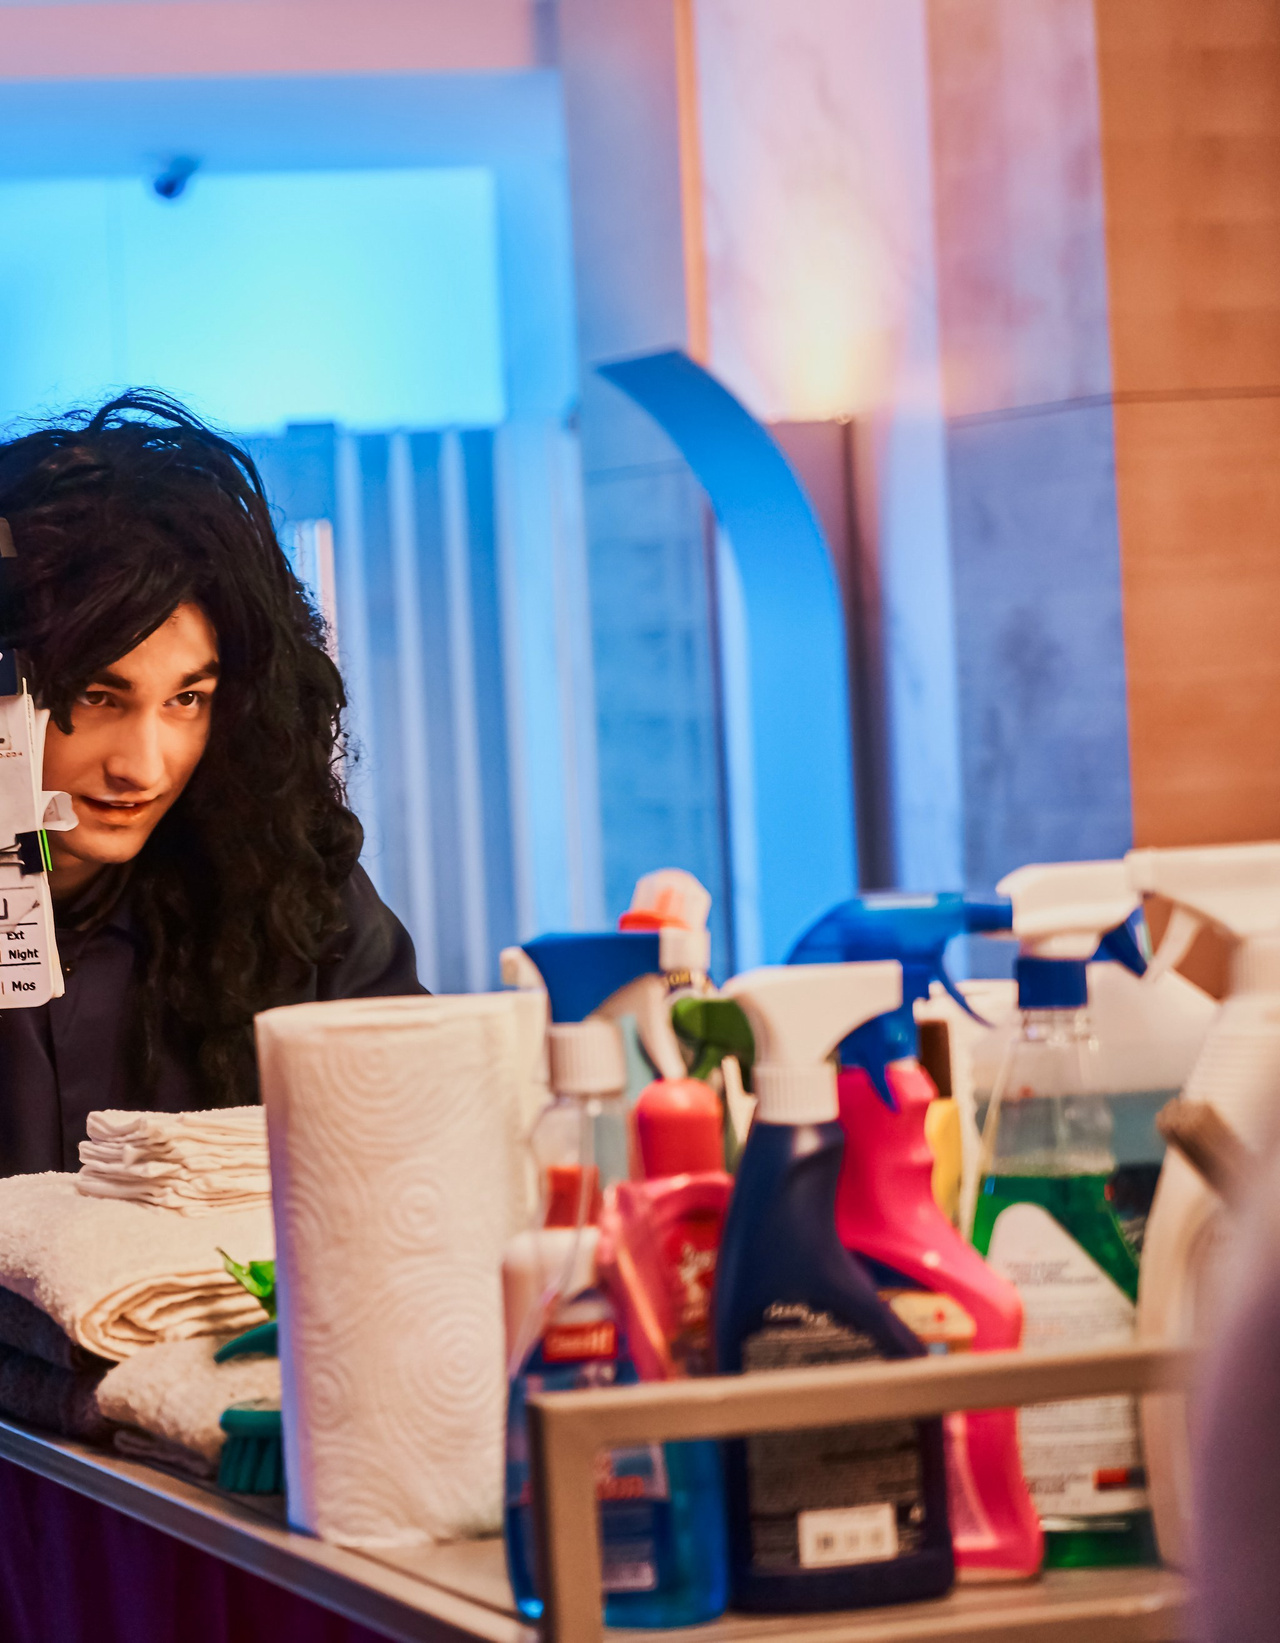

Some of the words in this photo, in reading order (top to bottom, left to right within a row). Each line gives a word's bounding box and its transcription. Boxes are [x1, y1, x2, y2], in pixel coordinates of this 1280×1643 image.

[7, 931, 25, 940] Ext
[9, 949, 39, 961] Night
[12, 981, 36, 992] Mos
